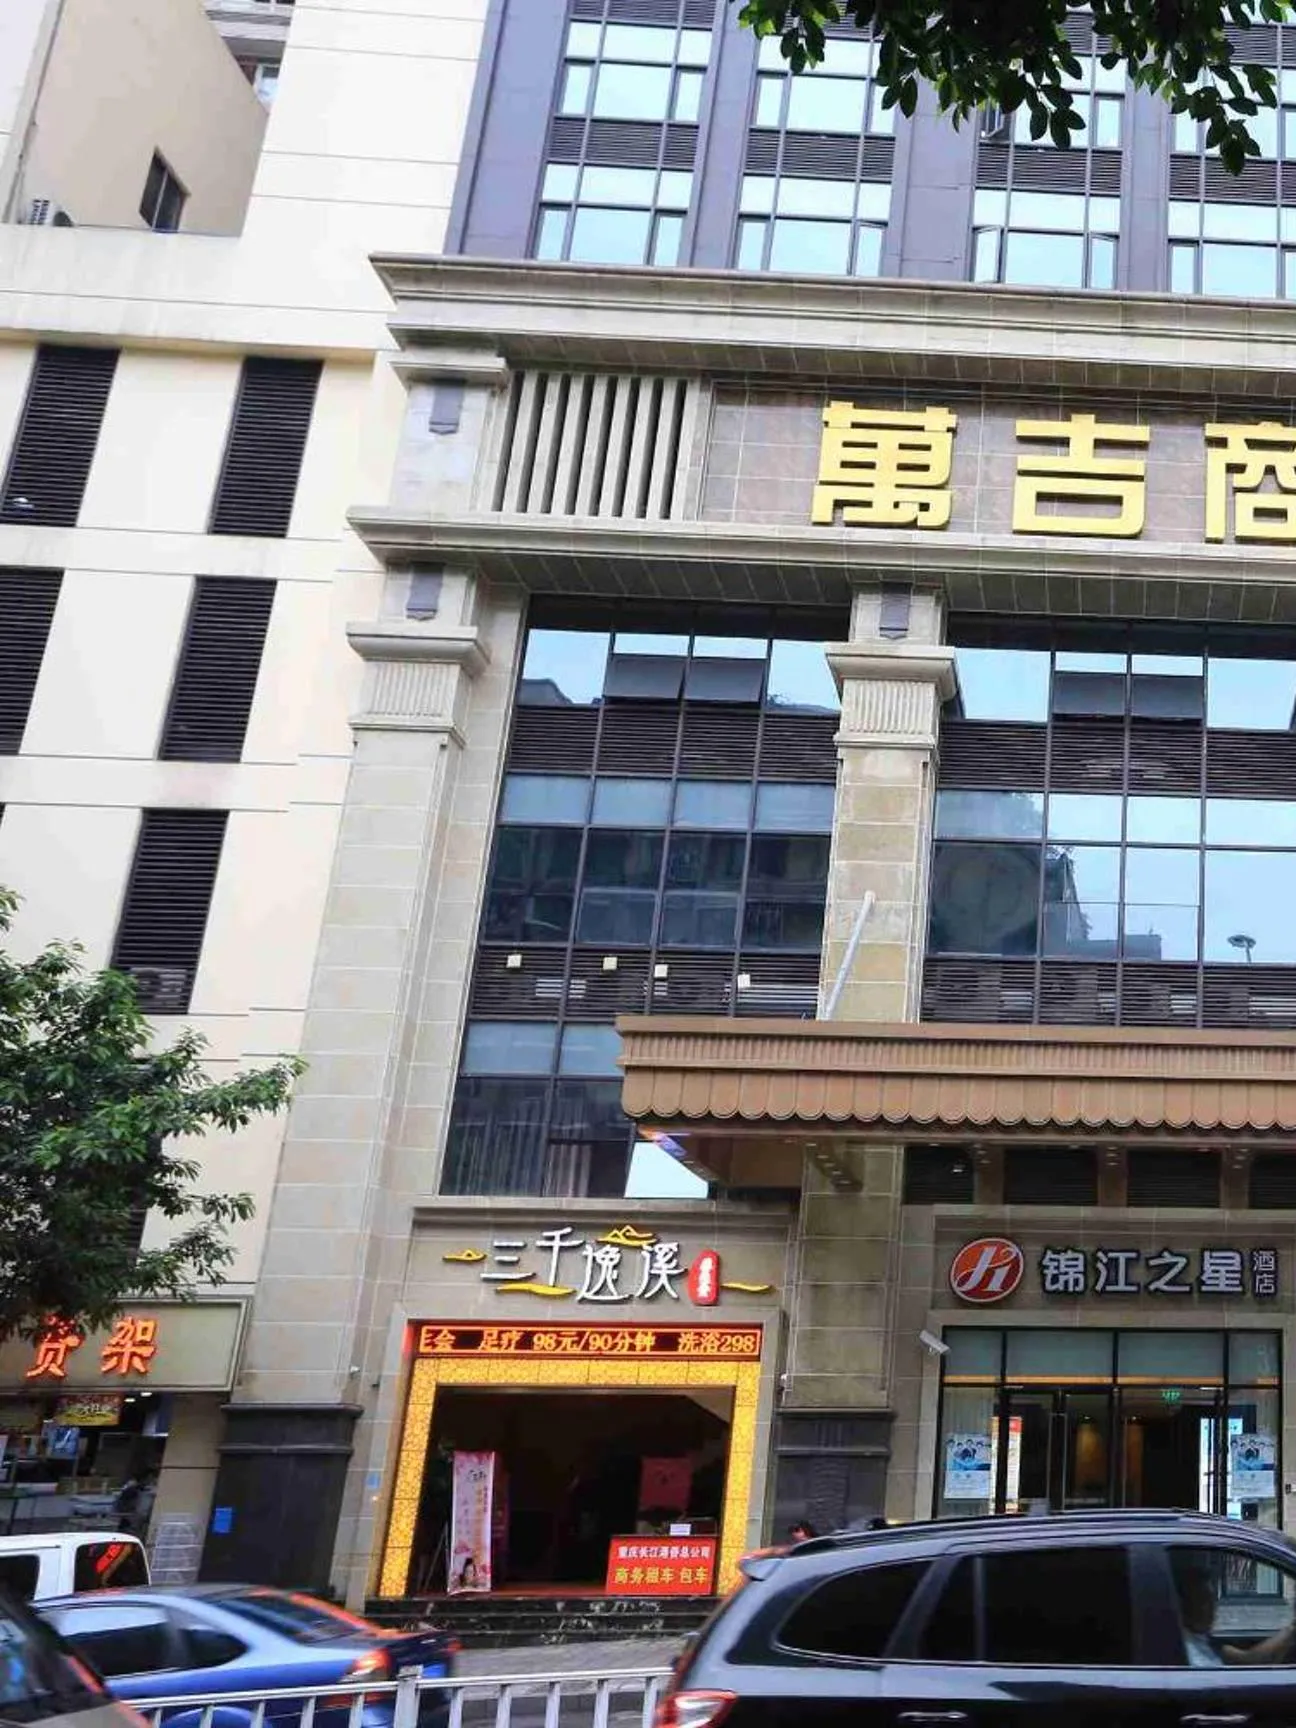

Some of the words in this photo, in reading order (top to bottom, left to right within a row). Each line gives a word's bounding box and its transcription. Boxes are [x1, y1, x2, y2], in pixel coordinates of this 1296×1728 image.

[1041, 1249, 1243, 1293] 锦江之星
[1253, 1250, 1276, 1295] 酒店
[26, 1312, 159, 1379] 货架
[478, 1328, 525, 1352] 足疗
[532, 1330, 656, 1353] 98元/90分钟
[677, 1331, 756, 1354] 洗浴298
